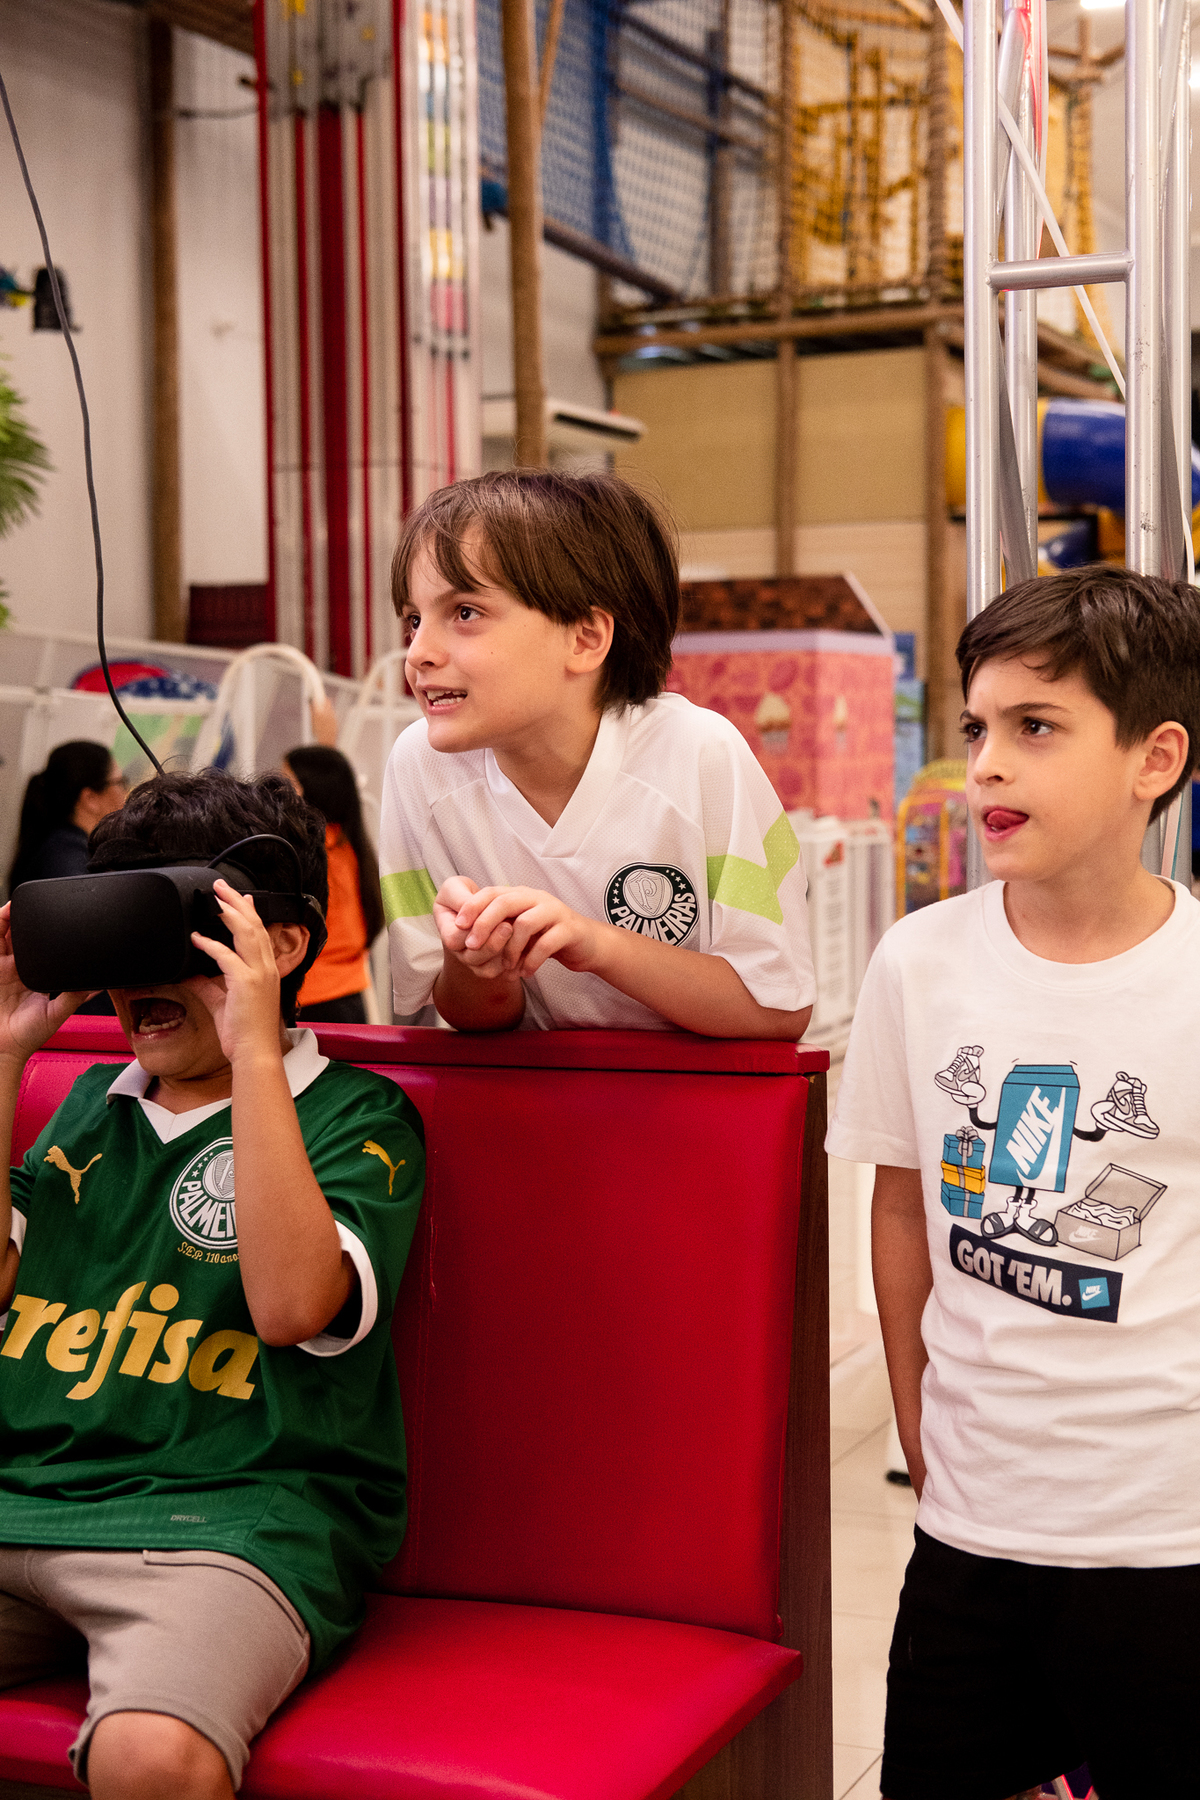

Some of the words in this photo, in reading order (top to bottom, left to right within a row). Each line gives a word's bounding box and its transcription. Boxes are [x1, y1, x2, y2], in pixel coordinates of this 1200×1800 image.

[1006, 1085, 1057, 1175] NIKE
[957, 1239, 1005, 1287] GOT
[0, 1281, 259, 1400] refisa
[170, 1514, 207, 1523] DRYCELL
